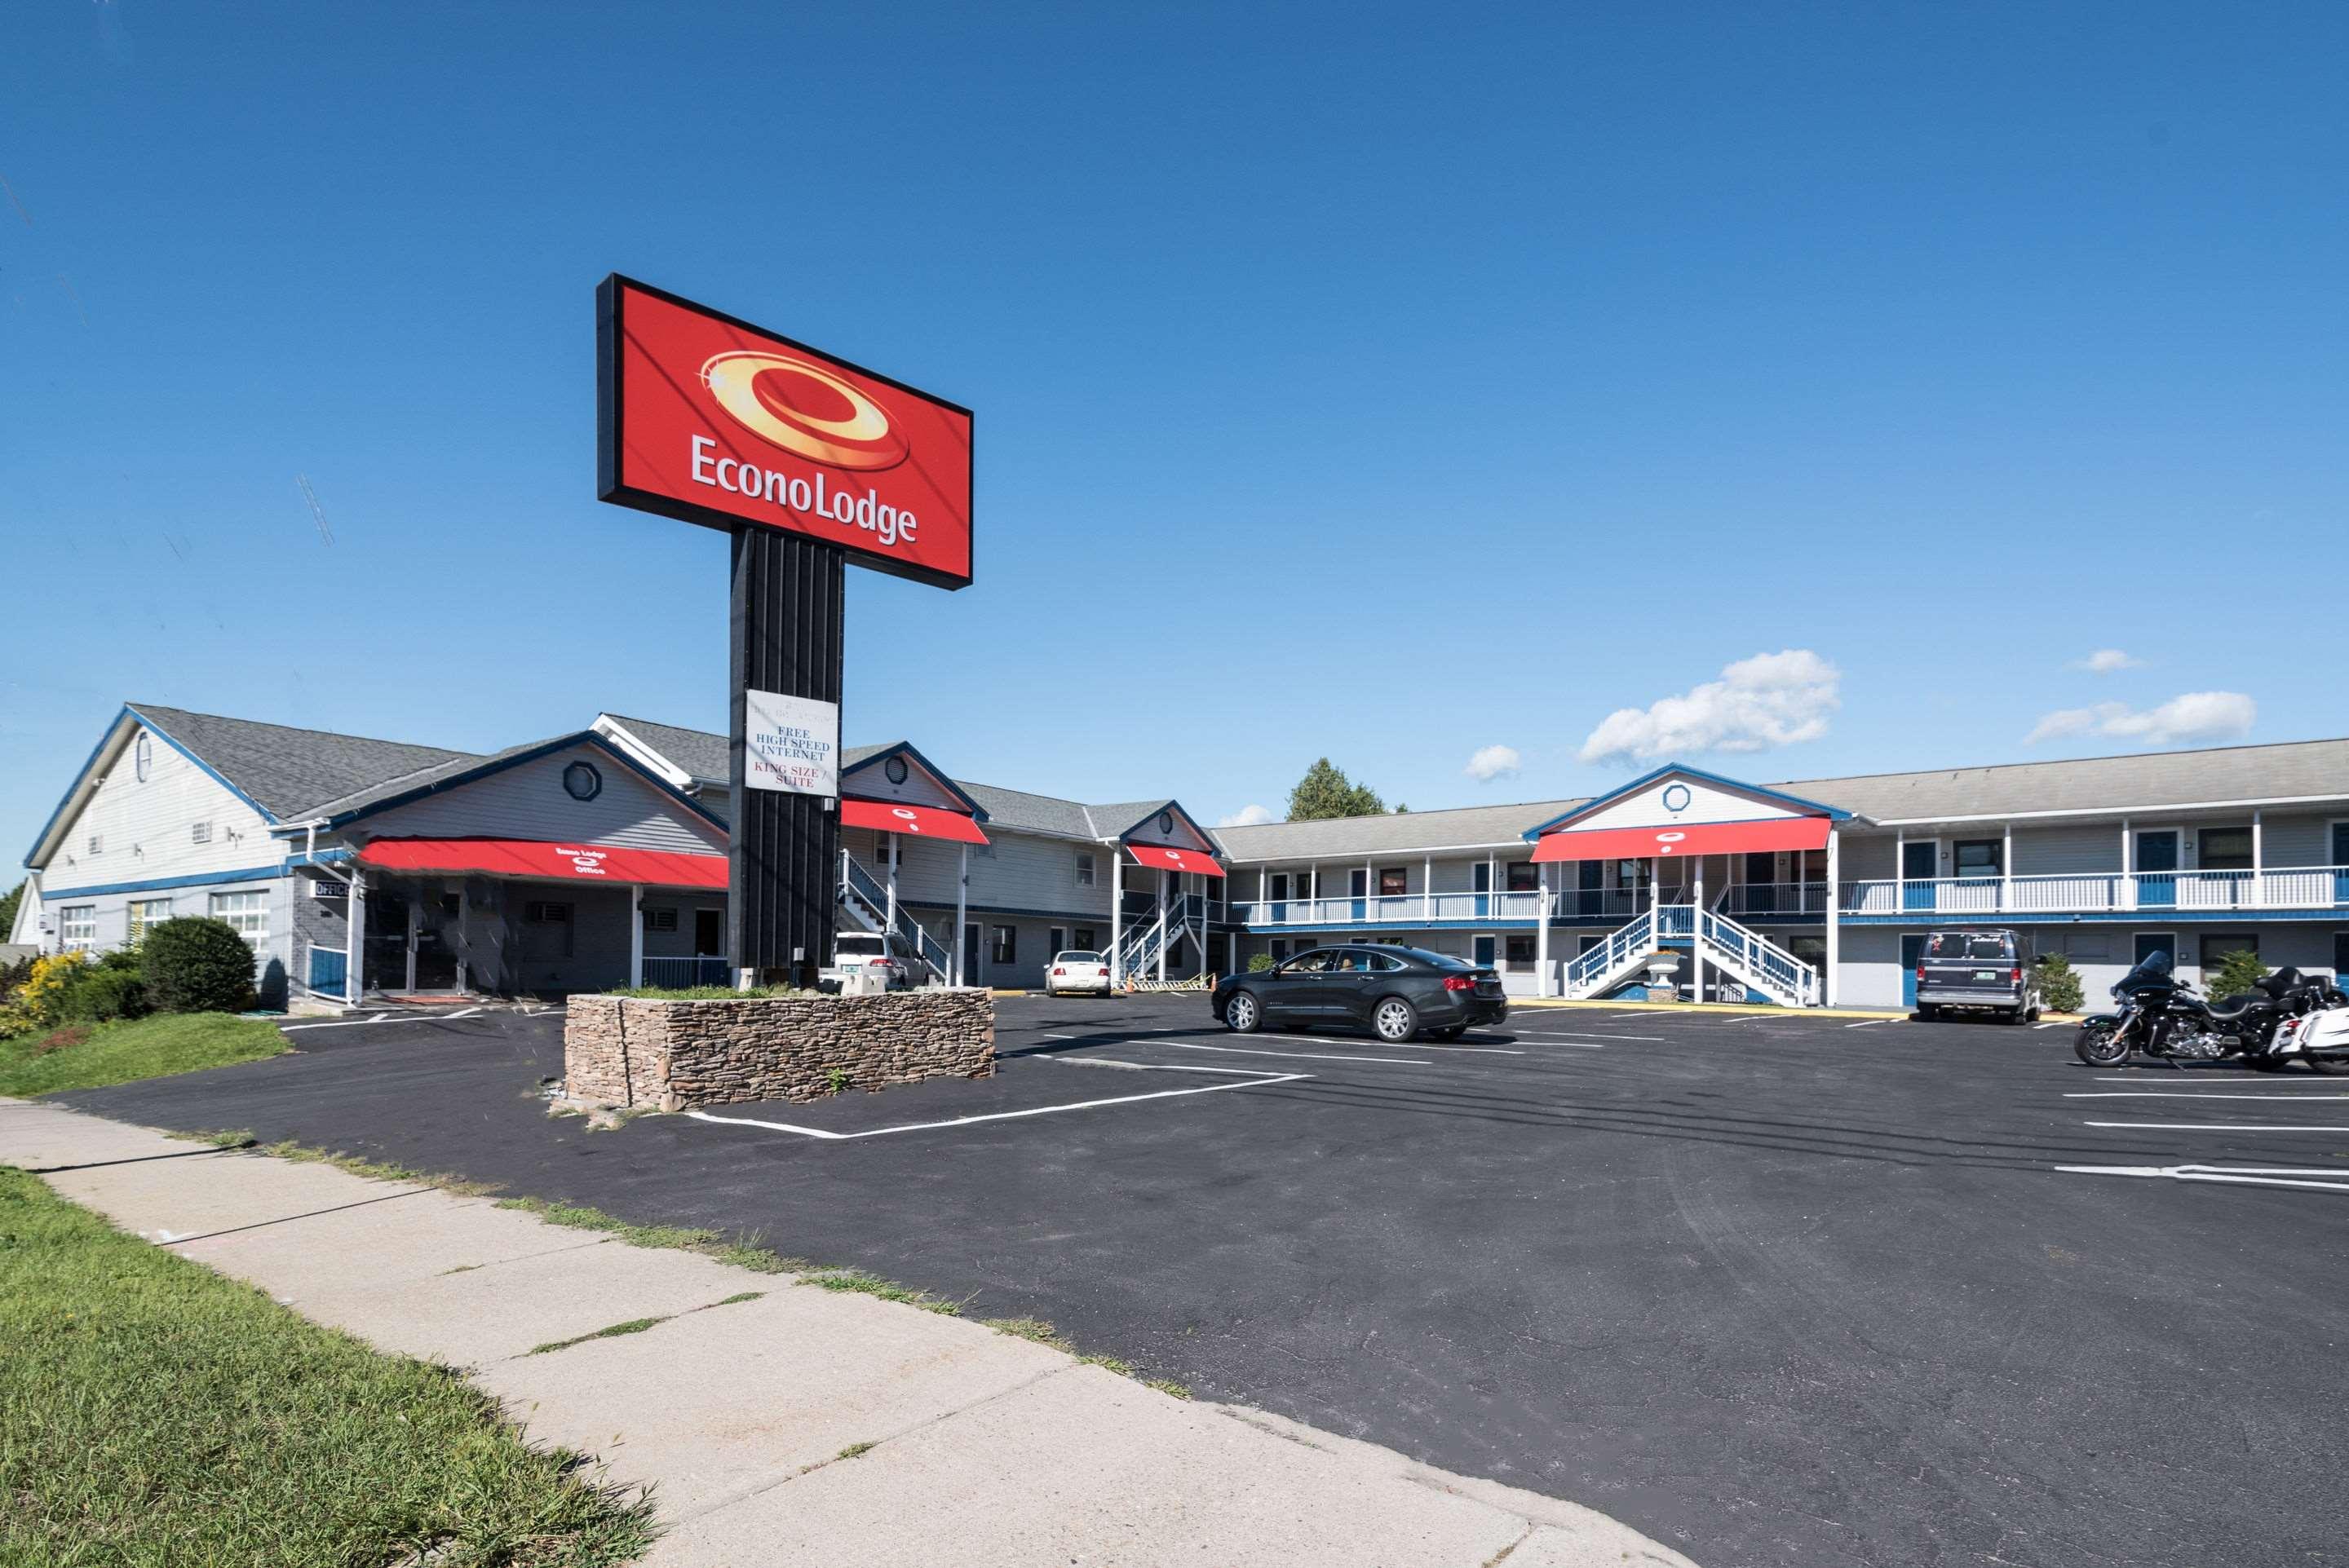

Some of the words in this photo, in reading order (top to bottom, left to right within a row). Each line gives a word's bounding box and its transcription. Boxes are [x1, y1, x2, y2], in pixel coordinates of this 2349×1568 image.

[692, 434, 918, 545] EconoLodge
[778, 726, 810, 739] FREE
[757, 734, 787, 746] HIGH
[790, 739, 829, 752] SPEED
[762, 745, 825, 761] INTERNET
[754, 762, 786, 774] KING
[790, 766, 819, 778] SIZE
[776, 775, 814, 788] SUITE
[576, 867, 606, 875] Office
